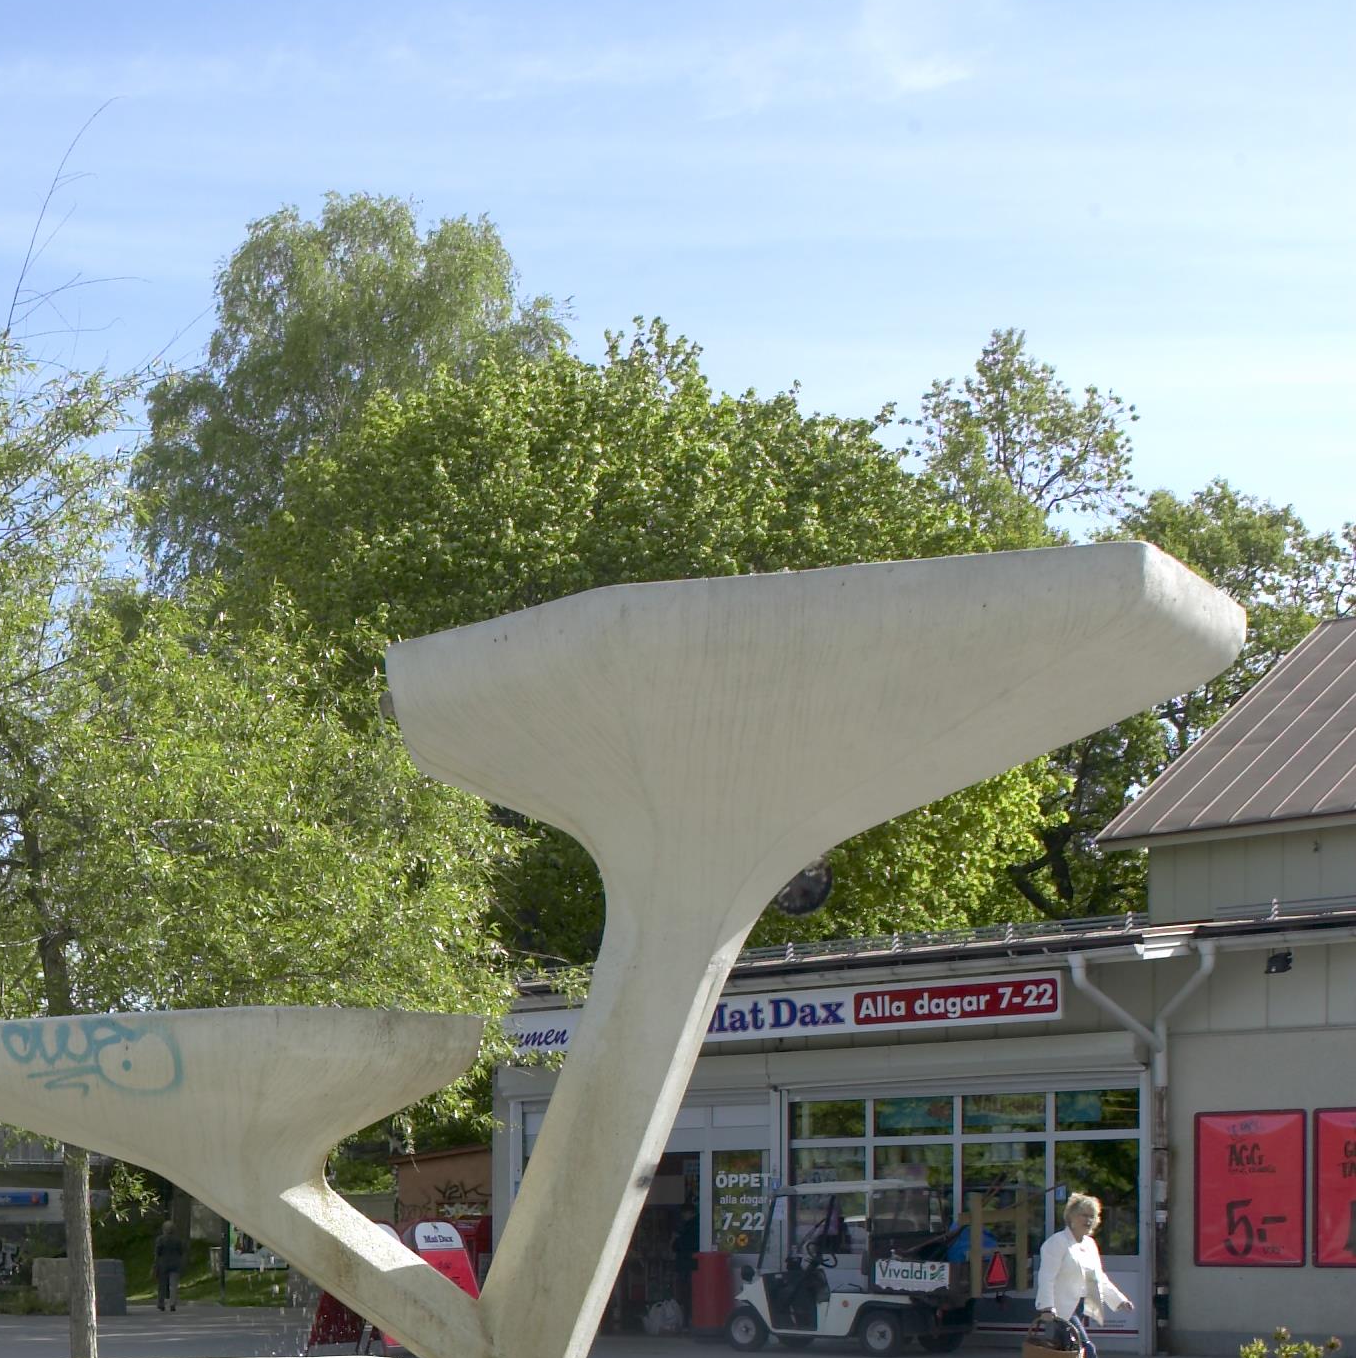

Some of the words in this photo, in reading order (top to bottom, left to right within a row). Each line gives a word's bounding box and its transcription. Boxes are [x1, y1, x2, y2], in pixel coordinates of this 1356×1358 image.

[858, 995, 906, 1019] Alla
[913, 991, 990, 1019] dagar
[997, 983, 1054, 1009] 7-22
[768, 997, 846, 1030] Dax
[715, 1170, 771, 1189] ÖPPET
[719, 1194, 738, 1204] alla
[722, 1211, 765, 1231] 7-22
[423, 1234, 439, 1243] Mat
[878, 1260, 928, 1281] Vivaldi
